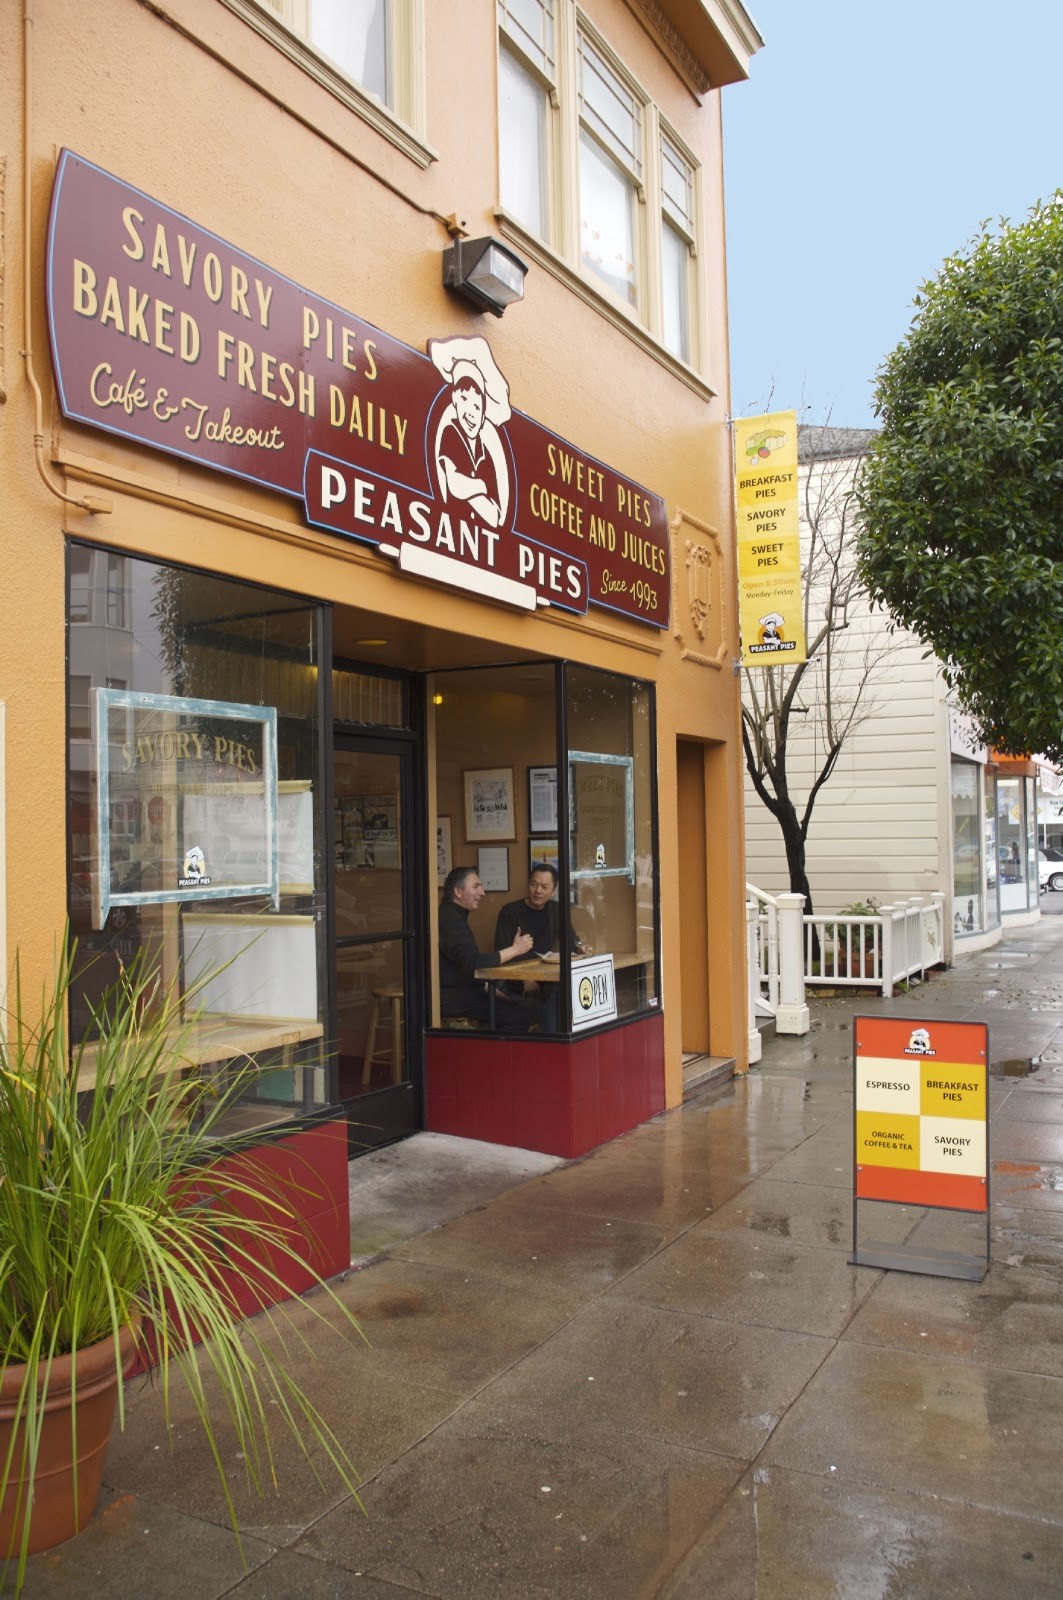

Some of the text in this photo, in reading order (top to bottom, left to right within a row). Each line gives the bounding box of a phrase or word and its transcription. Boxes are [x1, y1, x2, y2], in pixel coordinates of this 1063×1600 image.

[121, 206, 378, 381] SAVORY PIES
[73, 259, 408, 455] BAKED FRESH DAILY
[90, 362, 285, 450] Café & Takeout
[547, 443, 652, 528] SWEET PIES
[739, 473, 793, 489] BREAKFAST
[755, 488, 776, 499] PIES
[747, 508, 786, 521] SAVORY
[320, 465, 582, 599] PEASANT PIES
[530, 483, 666, 577] COFFEE AND JUICES
[756, 522, 777, 533] PIES
[751, 542, 784, 555] SWEET
[757, 556, 779, 567] PIES
[600, 568, 658, 611] Since 1993
[742, 581, 764, 590] Open
[750, 642, 795, 653] PEASANT PIES
[122, 731, 257, 775] SAVORY PIES
[866, 1080, 911, 1092] ESPRESSO
[926, 1080, 979, 1092] BREAKFAST
[942, 1092, 963, 1102] PIES
[871, 1130, 905, 1141] ORGANIC
[934, 1135, 971, 1147] SAVORY
[864, 1139, 891, 1149] COFFEE
[899, 1143, 913, 1151] TEA
[942, 1147, 963, 1157] PIES
